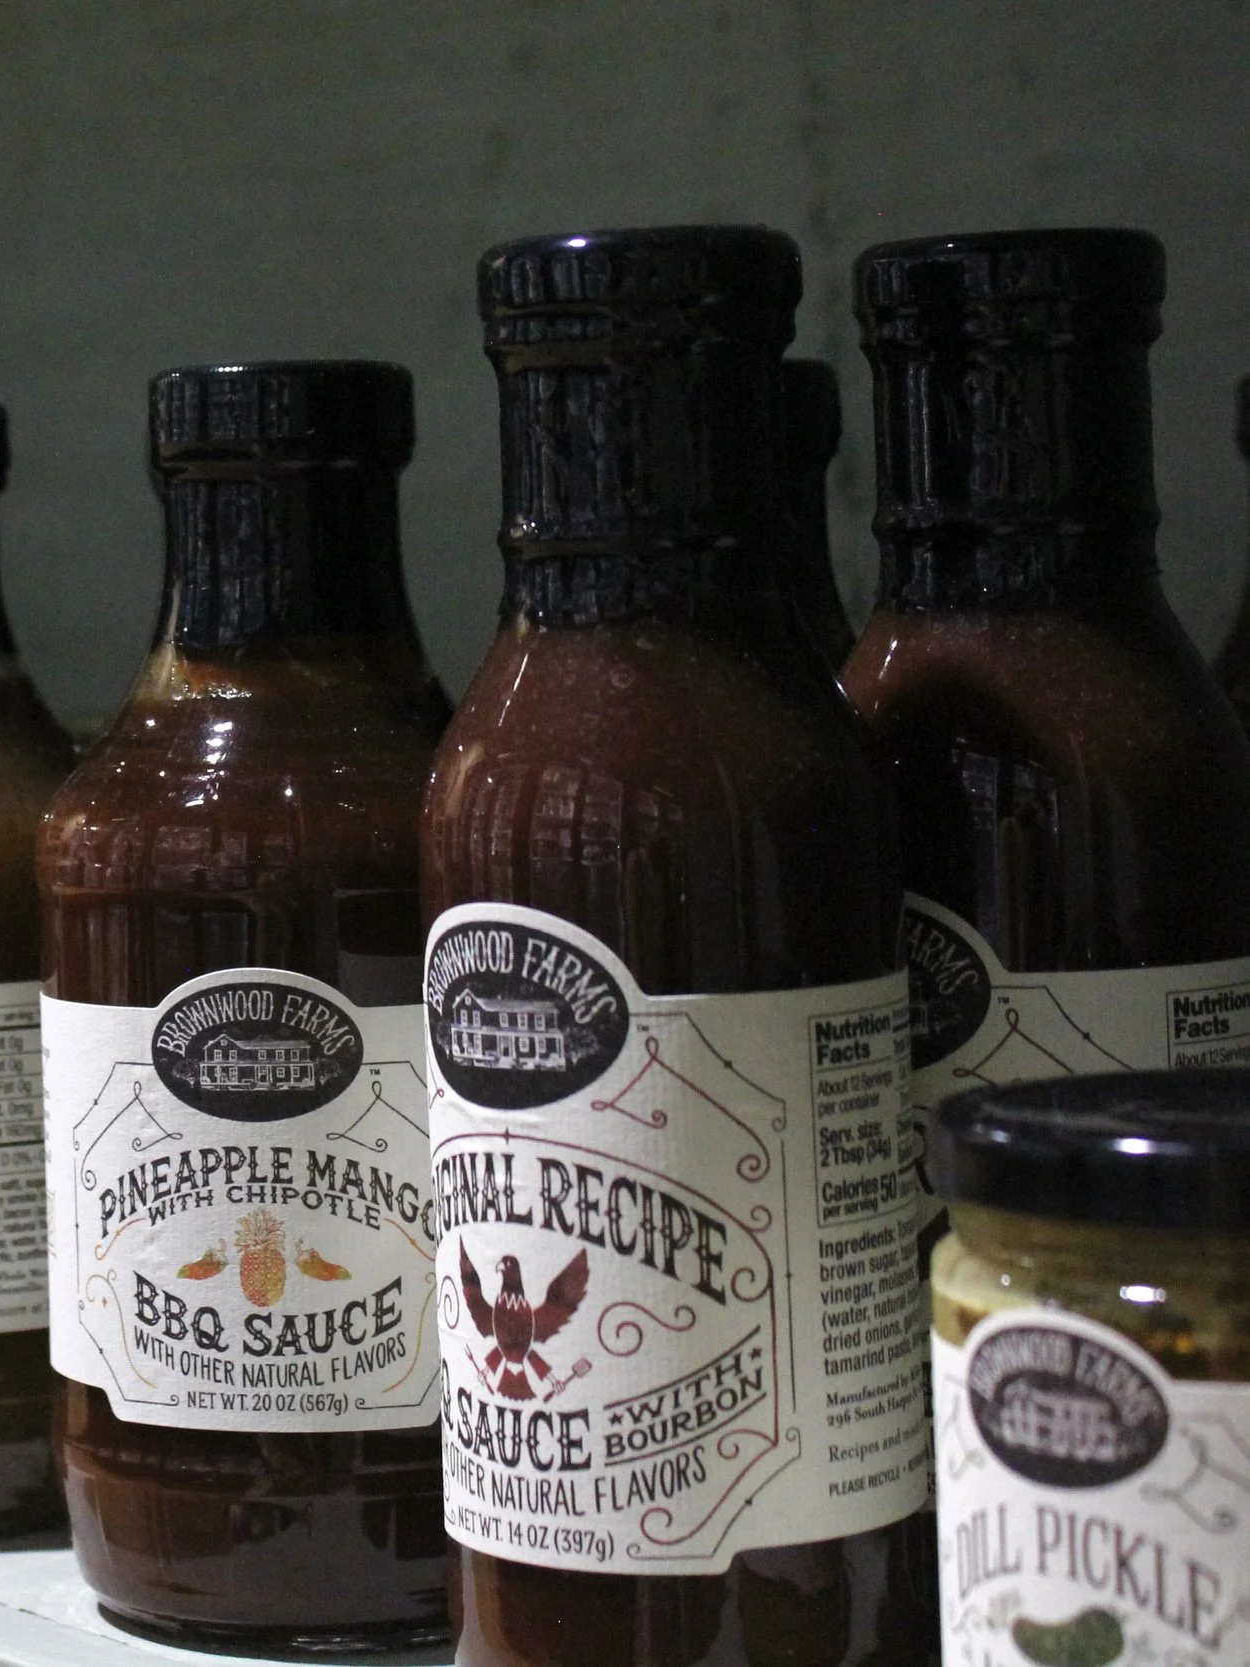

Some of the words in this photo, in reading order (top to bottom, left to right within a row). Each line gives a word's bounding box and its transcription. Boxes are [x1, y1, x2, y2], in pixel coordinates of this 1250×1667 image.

[908, 920, 979, 996] ARMS
[429, 930, 515, 1016] BROWNWOOD
[522, 937, 617, 1025] FARMS
[157, 990, 275, 1057] BROWNWOOD
[281, 993, 355, 1057] FARMS
[815, 1014, 891, 1043] Nutrition
[1174, 1016, 1230, 1039] Facts
[816, 1040, 871, 1066] Facts
[817, 1079, 849, 1098] About
[818, 1101, 837, 1120] per
[839, 1092, 880, 1114] container
[819, 1126, 855, 1148] Serv.
[820, 1150, 830, 1168] 2
[833, 1144, 864, 1166] Tbsp
[866, 1135, 892, 1164] (34g)
[99, 1146, 293, 1239] PINEAPPLE
[822, 1175, 879, 1204] Calories
[880, 1170, 897, 1202] 50
[147, 1188, 214, 1228] WITH
[226, 1184, 382, 1232] CHIPOTLE
[823, 1204, 841, 1222] per
[844, 1199, 879, 1216] serving
[432, 1152, 534, 1248] IGINAL
[536, 1156, 727, 1306] RECIPE
[820, 1259, 866, 1283] brown
[869, 1251, 899, 1275] sugar,
[821, 1280, 876, 1306] vinegar,
[133, 1270, 231, 1354] BBQ
[243, 1276, 403, 1358] SAUCE
[822, 1306, 871, 1333] (water,
[873, 1290, 907, 1318] natural
[133, 1324, 176, 1373] WITH
[179, 1351, 235, 1389] OTHER
[241, 1361, 325, 1389] NATURAL
[330, 1331, 407, 1382] FLAVORS
[823, 1328, 862, 1354] dried
[824, 1345, 885, 1377] tamarind
[186, 1391, 221, 1409] NET
[221, 1391, 249, 1410] WT.
[250, 1393, 273, 1411] 20
[276, 1394, 298, 1411] OZ
[299, 1393, 351, 1417] (567g)
[626, 1352, 743, 1425] WITH
[826, 1375, 900, 1409] Manufactured
[604, 1366, 764, 1458] BOURBON
[827, 1408, 852, 1430] 296
[854, 1400, 886, 1422] South
[456, 1386, 592, 1474] SAUCE
[829, 1442, 880, 1462] Recipes
[882, 1427, 902, 1451] and
[450, 1441, 486, 1502] OTHER
[491, 1470, 586, 1517] NATURAL
[594, 1445, 707, 1514] FLAVORS
[829, 1475, 866, 1498] PLEASE
[868, 1463, 901, 1489] RECYCLE
[458, 1505, 477, 1533] NET
[508, 1520, 524, 1547] 14
[526, 1523, 550, 1550] OZ
[554, 1525, 615, 1563] (397g)
[956, 1502, 1022, 1599] DILL
[1035, 1503, 1223, 1650] PICKLE
